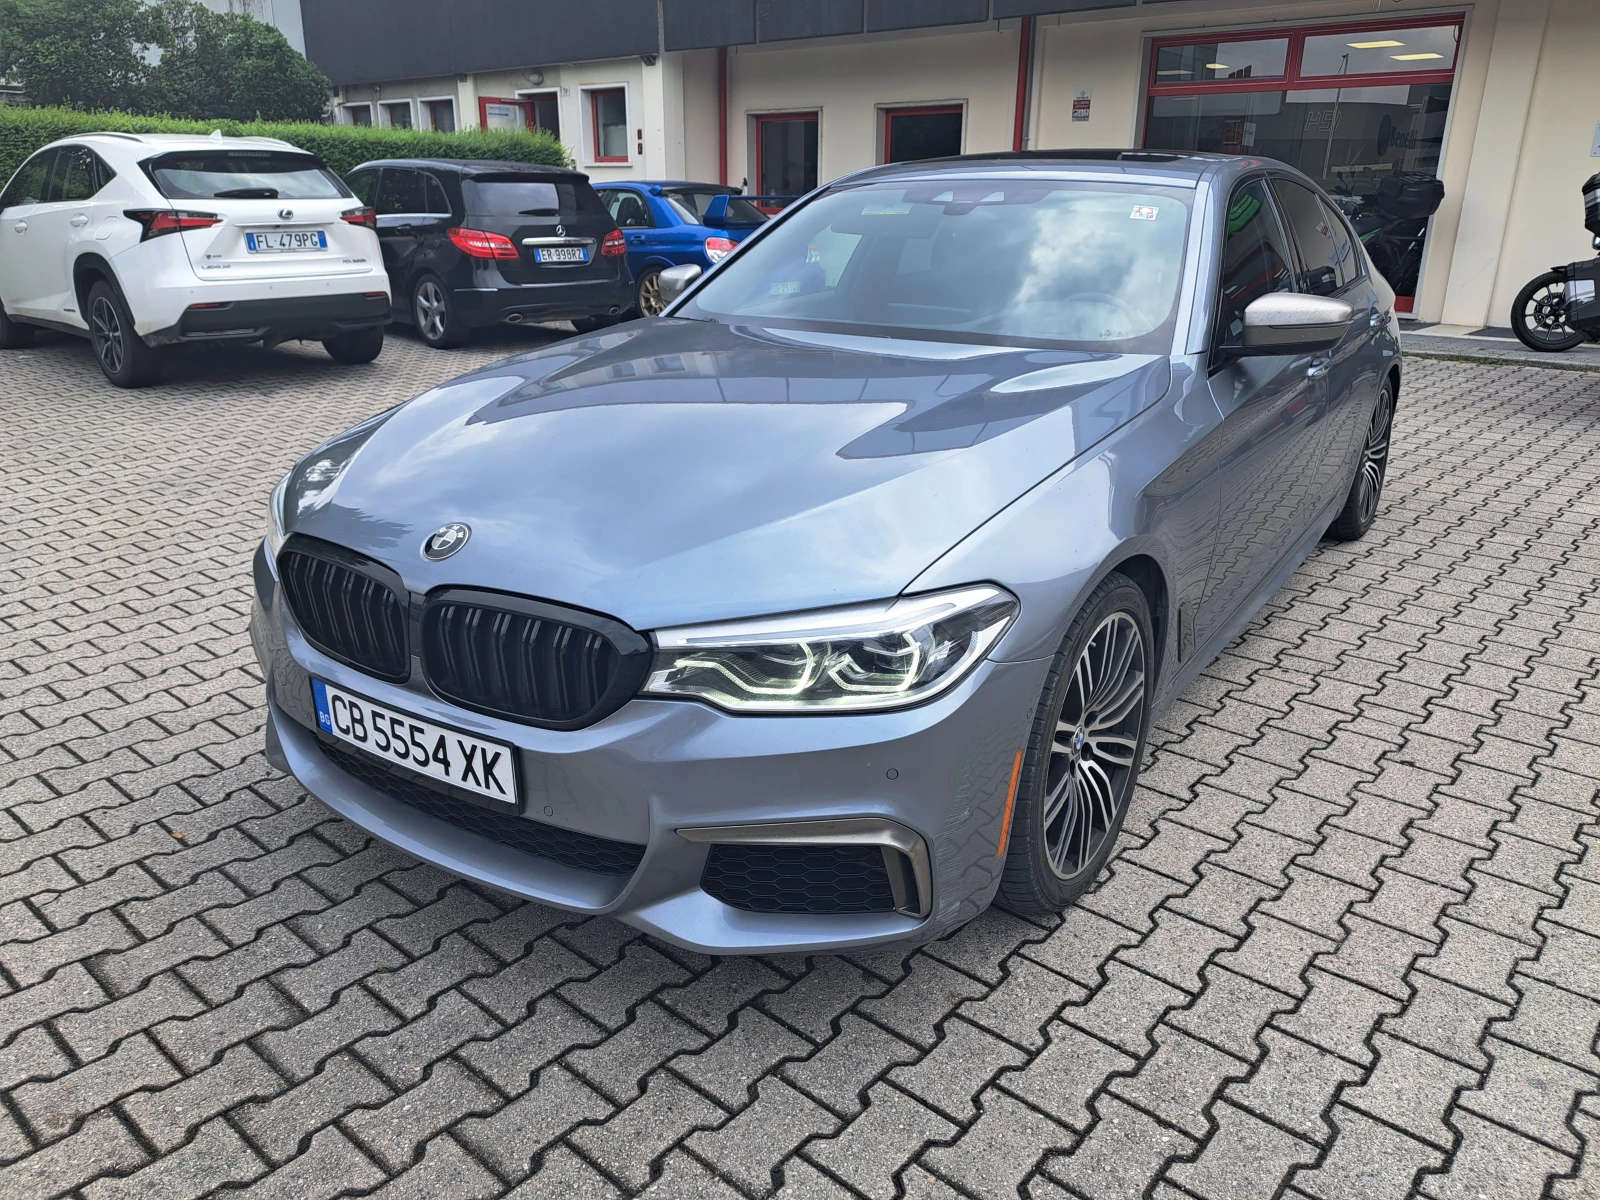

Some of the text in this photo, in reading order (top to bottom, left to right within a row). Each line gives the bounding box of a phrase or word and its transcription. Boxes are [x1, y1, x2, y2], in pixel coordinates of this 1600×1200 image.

[256, 234, 318, 248] FL 479PG
[541, 249, 553, 260] ER
[319, 711, 331, 726] BG
[331, 694, 507, 795] CB 5554 XK
